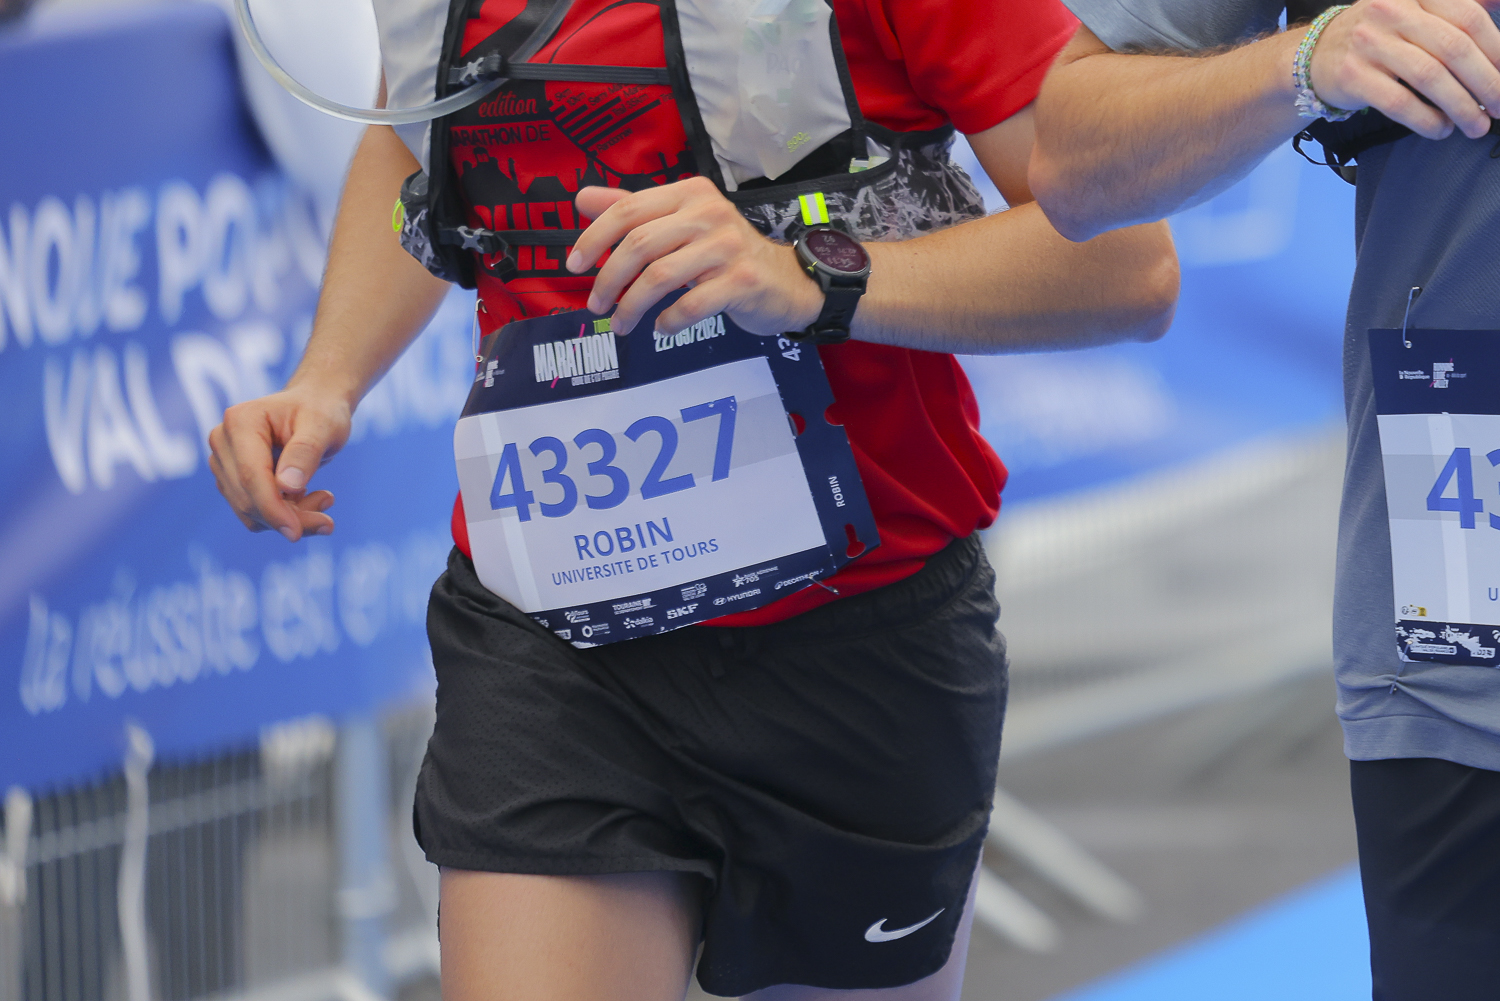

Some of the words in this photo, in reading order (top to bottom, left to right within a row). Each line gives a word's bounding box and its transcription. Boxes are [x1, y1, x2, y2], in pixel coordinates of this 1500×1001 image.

[450, 126, 523, 147] ARATHON
[526, 123, 551, 143] DE
[533, 332, 618, 382] MARATHON
[43, 342, 198, 494] VAL
[490, 395, 738, 522] 43327
[828, 475, 846, 508] ROBIN
[573, 517, 674, 561] ROBIN
[551, 560, 633, 586] UNIVERSITE
[637, 554, 659, 571] DE
[661, 538, 719, 565] TOURS
[666, 603, 699, 620] SKF
[727, 588, 762, 603] HYUNDAI
